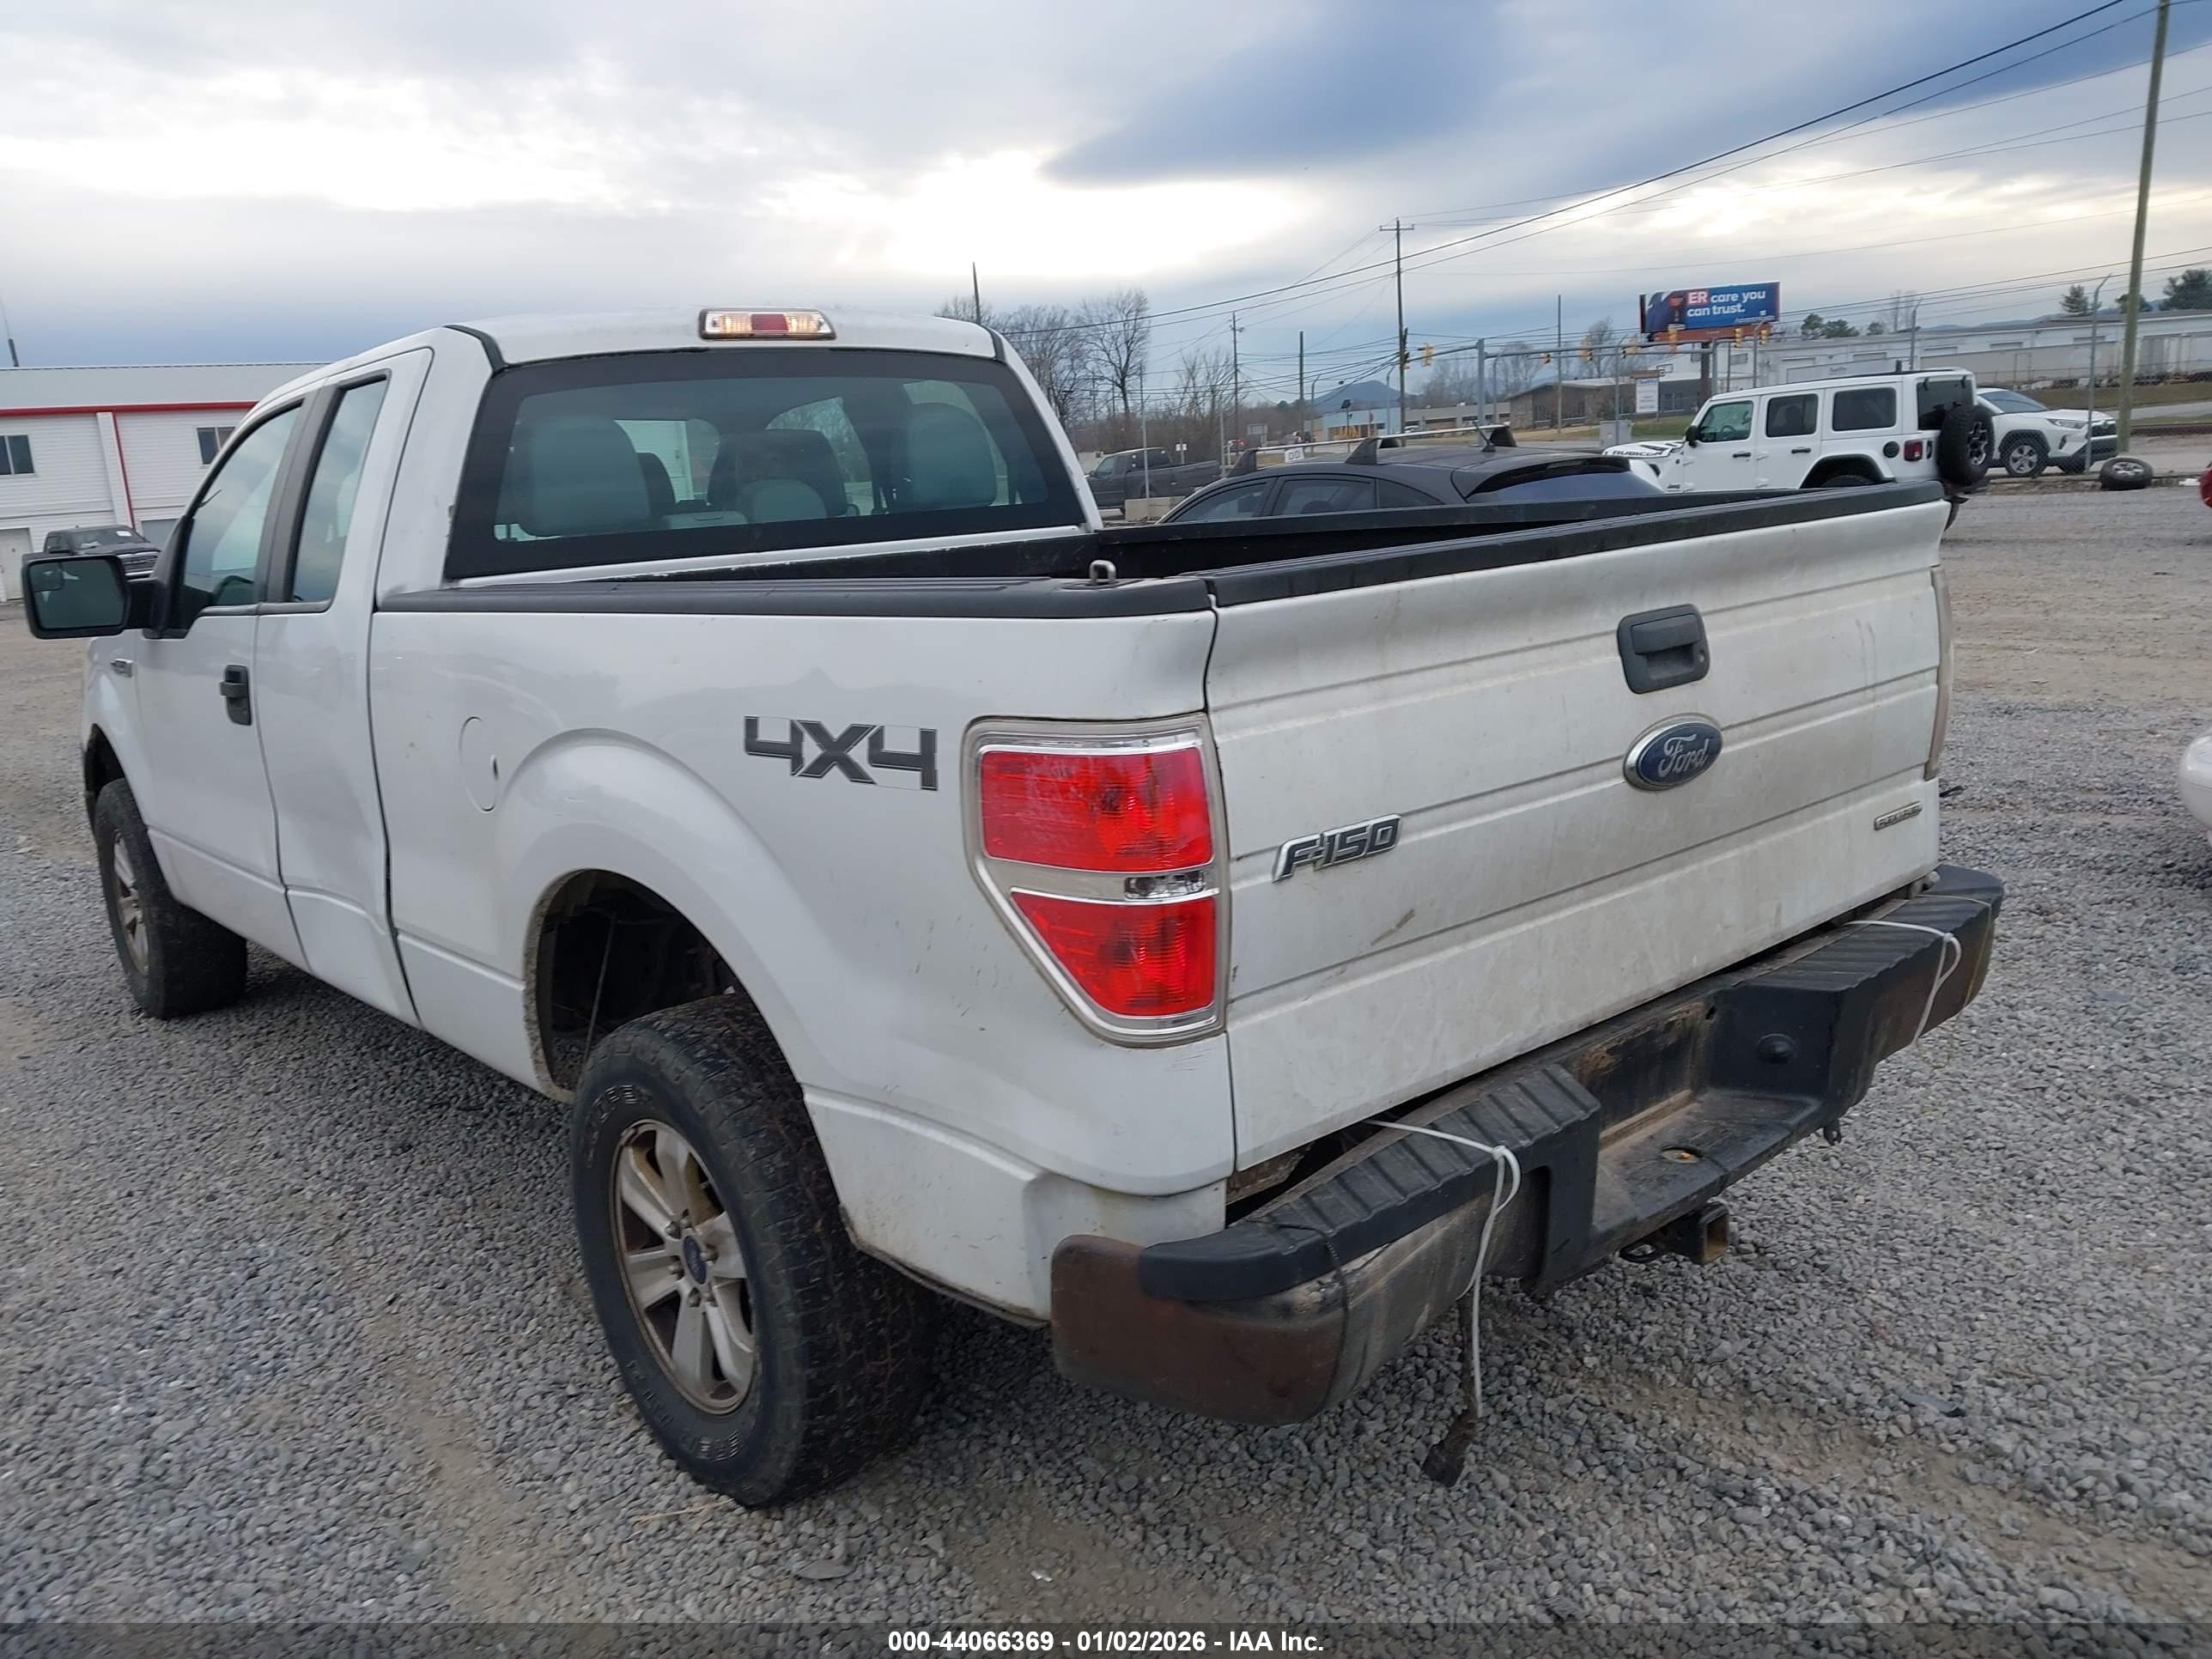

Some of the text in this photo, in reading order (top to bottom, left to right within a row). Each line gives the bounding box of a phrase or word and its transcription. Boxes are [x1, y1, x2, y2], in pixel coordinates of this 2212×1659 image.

[1687, 290, 1766, 304] ER care you
[1687, 304, 1745, 317] can trust.
[1657, 733, 1710, 778] Ford
[1272, 814, 1402, 884] F-150
